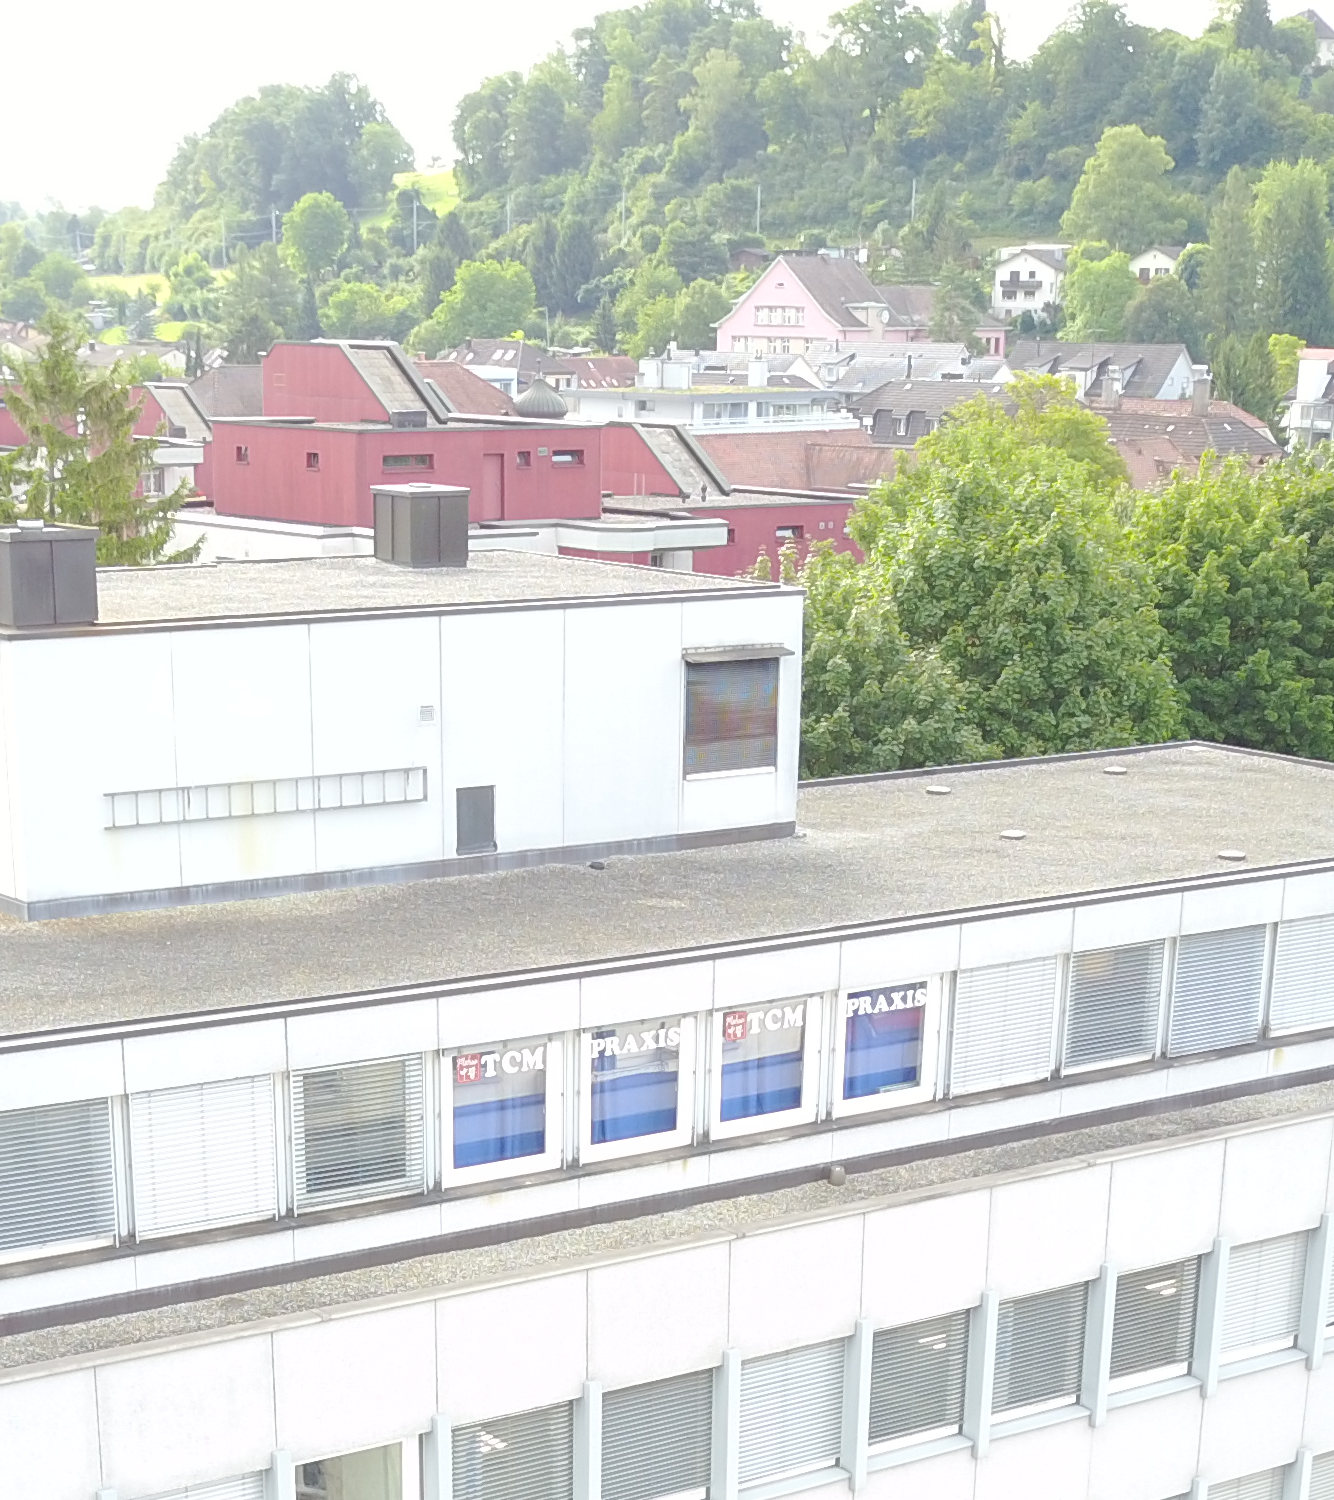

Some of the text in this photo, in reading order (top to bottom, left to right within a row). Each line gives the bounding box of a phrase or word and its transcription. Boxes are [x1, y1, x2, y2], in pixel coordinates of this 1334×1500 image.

[846, 988, 927, 1017] PRAXIS
[747, 1005, 804, 1034] TCM
[591, 1027, 680, 1058] PRAXIS
[481, 1046, 544, 1078] TCM
